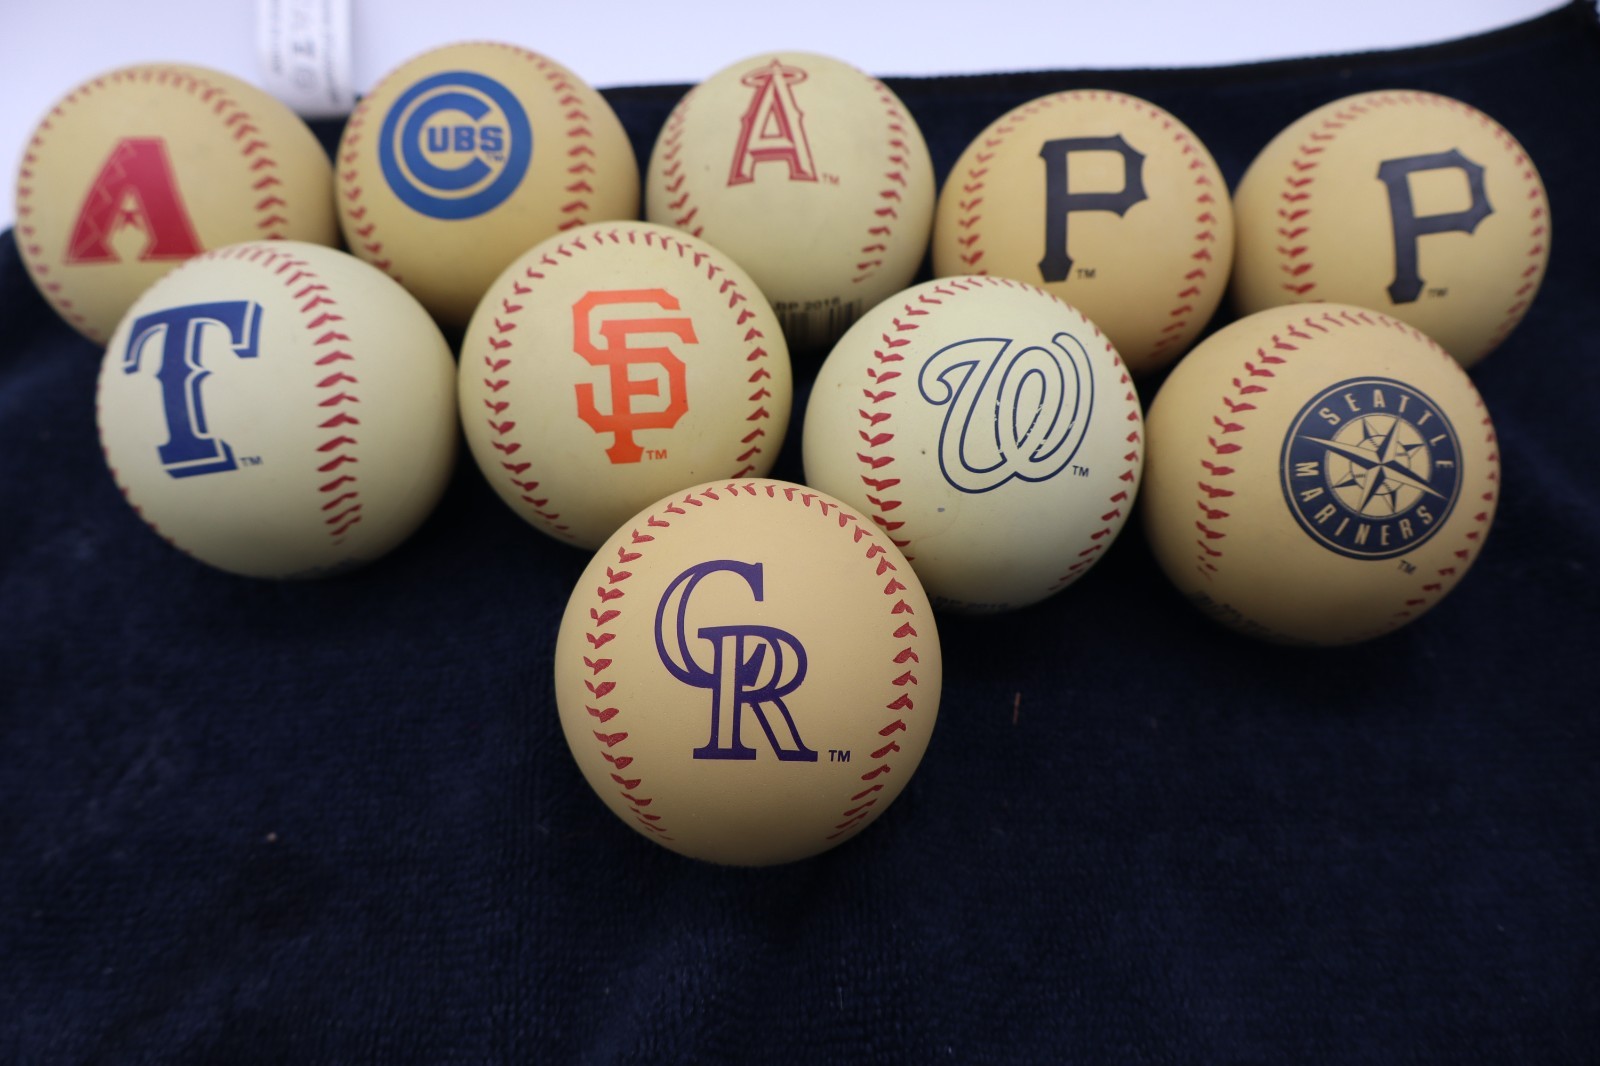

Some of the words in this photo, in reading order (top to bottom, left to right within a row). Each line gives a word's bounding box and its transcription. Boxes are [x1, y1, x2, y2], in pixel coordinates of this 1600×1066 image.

[727, 60, 819, 187] A
[64, 136, 203, 265] A
[822, 172, 840, 186] TM
[1038, 133, 1149, 283] P
[1376, 148, 1495, 305] P
[1077, 268, 1096, 280] TM
[1428, 288, 1448, 299] TM
[122, 300, 264, 479] T
[917, 331, 1095, 494] W
[1318, 388, 1454, 469] SEATTLE
[239, 456, 263, 467] TM
[646, 449, 668, 460] TM
[1072, 465, 1090, 478] TM
[1295, 460, 1434, 546] MARINERS
[1398, 559, 1416, 575] TM
[828, 750, 851, 763] TM
